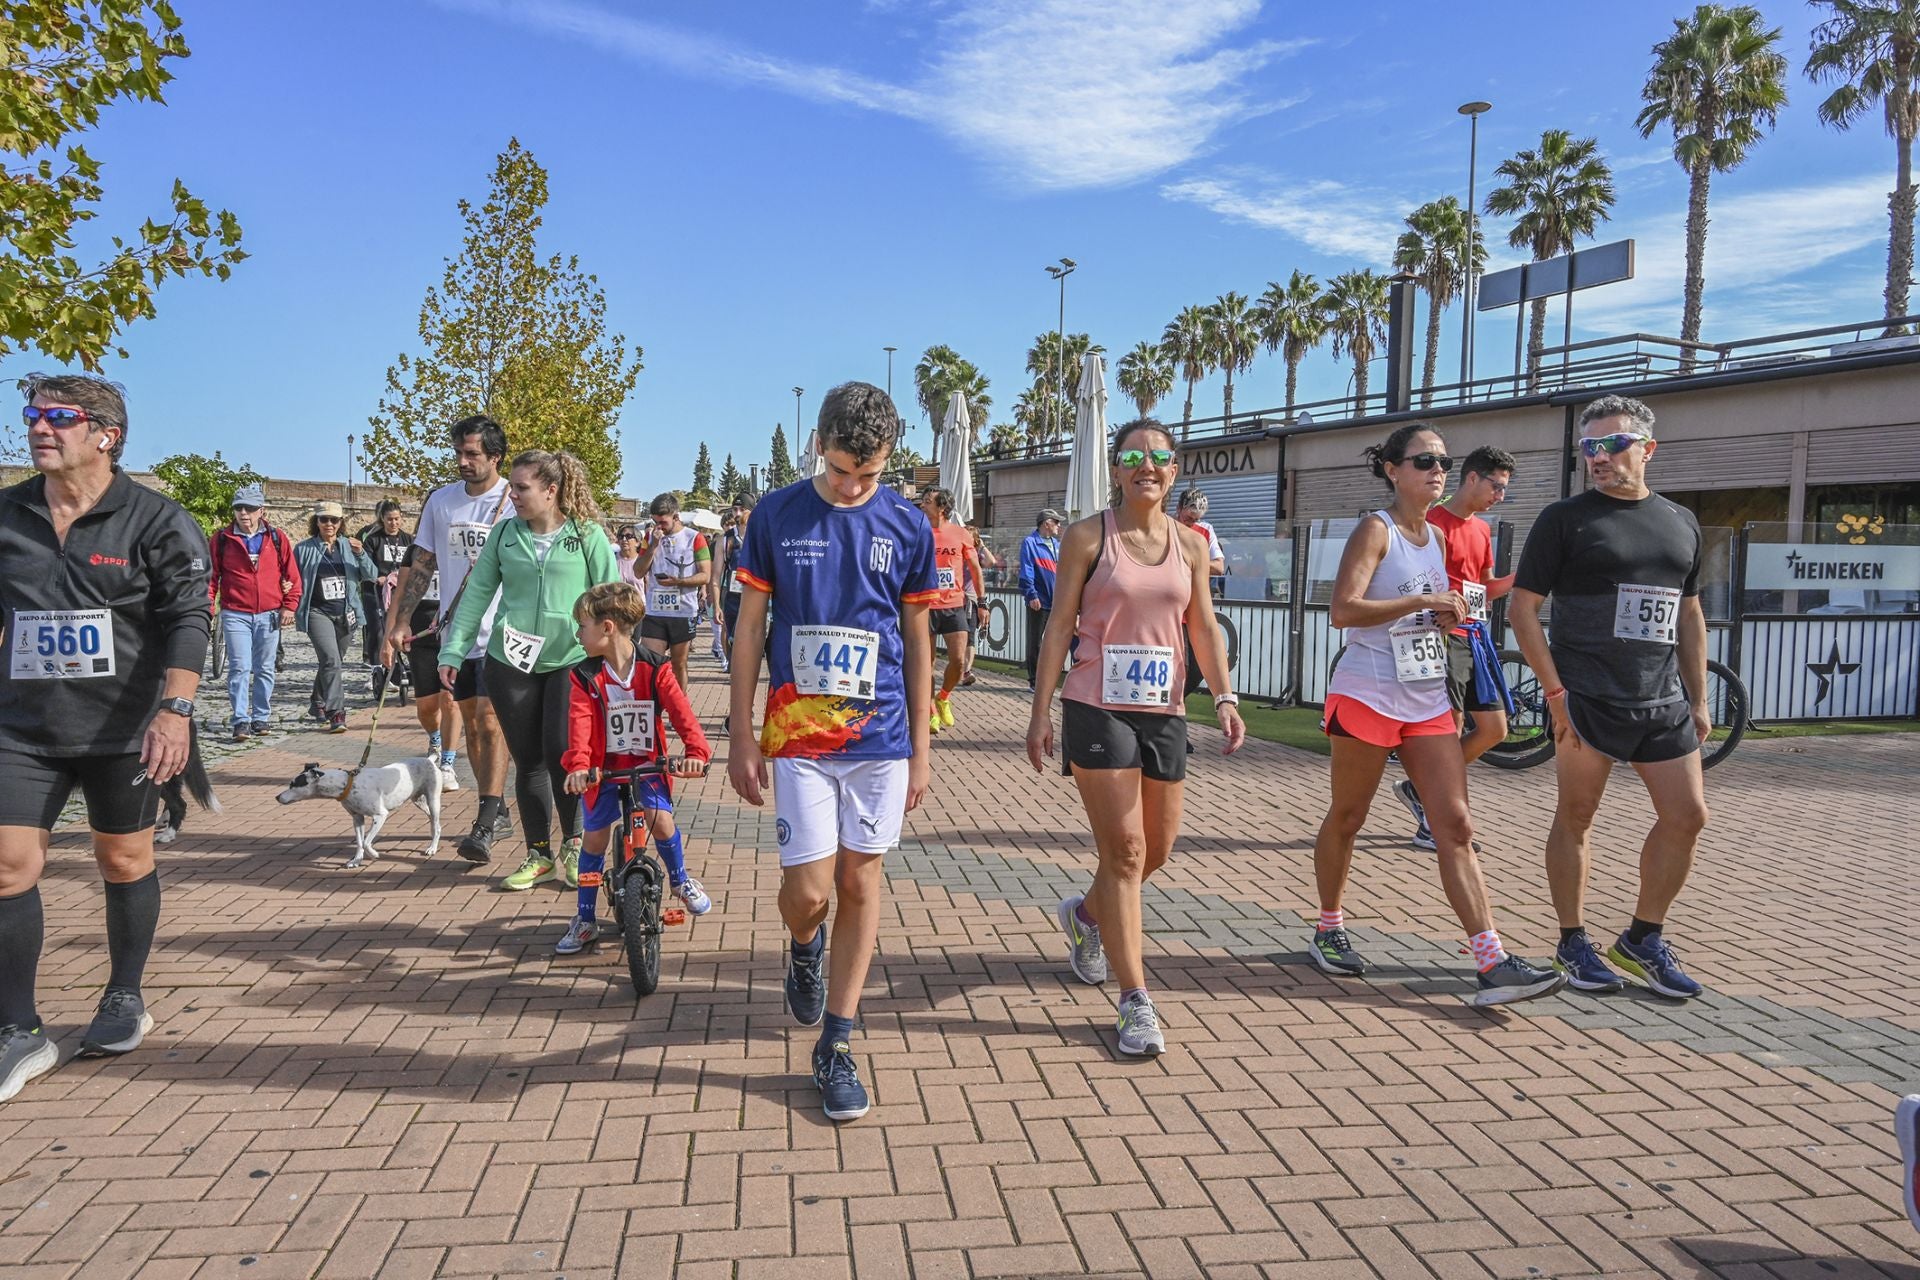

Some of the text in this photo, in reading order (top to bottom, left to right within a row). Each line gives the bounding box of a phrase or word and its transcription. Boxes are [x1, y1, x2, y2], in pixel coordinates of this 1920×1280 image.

[1182, 445, 1255, 476] LALOLA
[458, 530, 487, 548] 165
[791, 538, 831, 547] Santander
[103, 557, 129, 567] SPOT
[869, 542, 893, 574] 091
[938, 572, 952, 583] 20
[1397, 564, 1445, 596] READY TRA
[1793, 561, 1884, 580] HEINEKEN
[658, 594, 677, 605] 388
[1469, 590, 1484, 609] 558
[70, 613, 106, 621] DEPORTE
[1638, 598, 1676, 625] 557
[37, 624, 100, 657] 560
[796, 629, 818, 637] GRUPO
[814, 642, 869, 678] 447
[1412, 636, 1444, 662] 556
[1126, 659, 1169, 688] 448
[610, 711, 649, 736] 975
